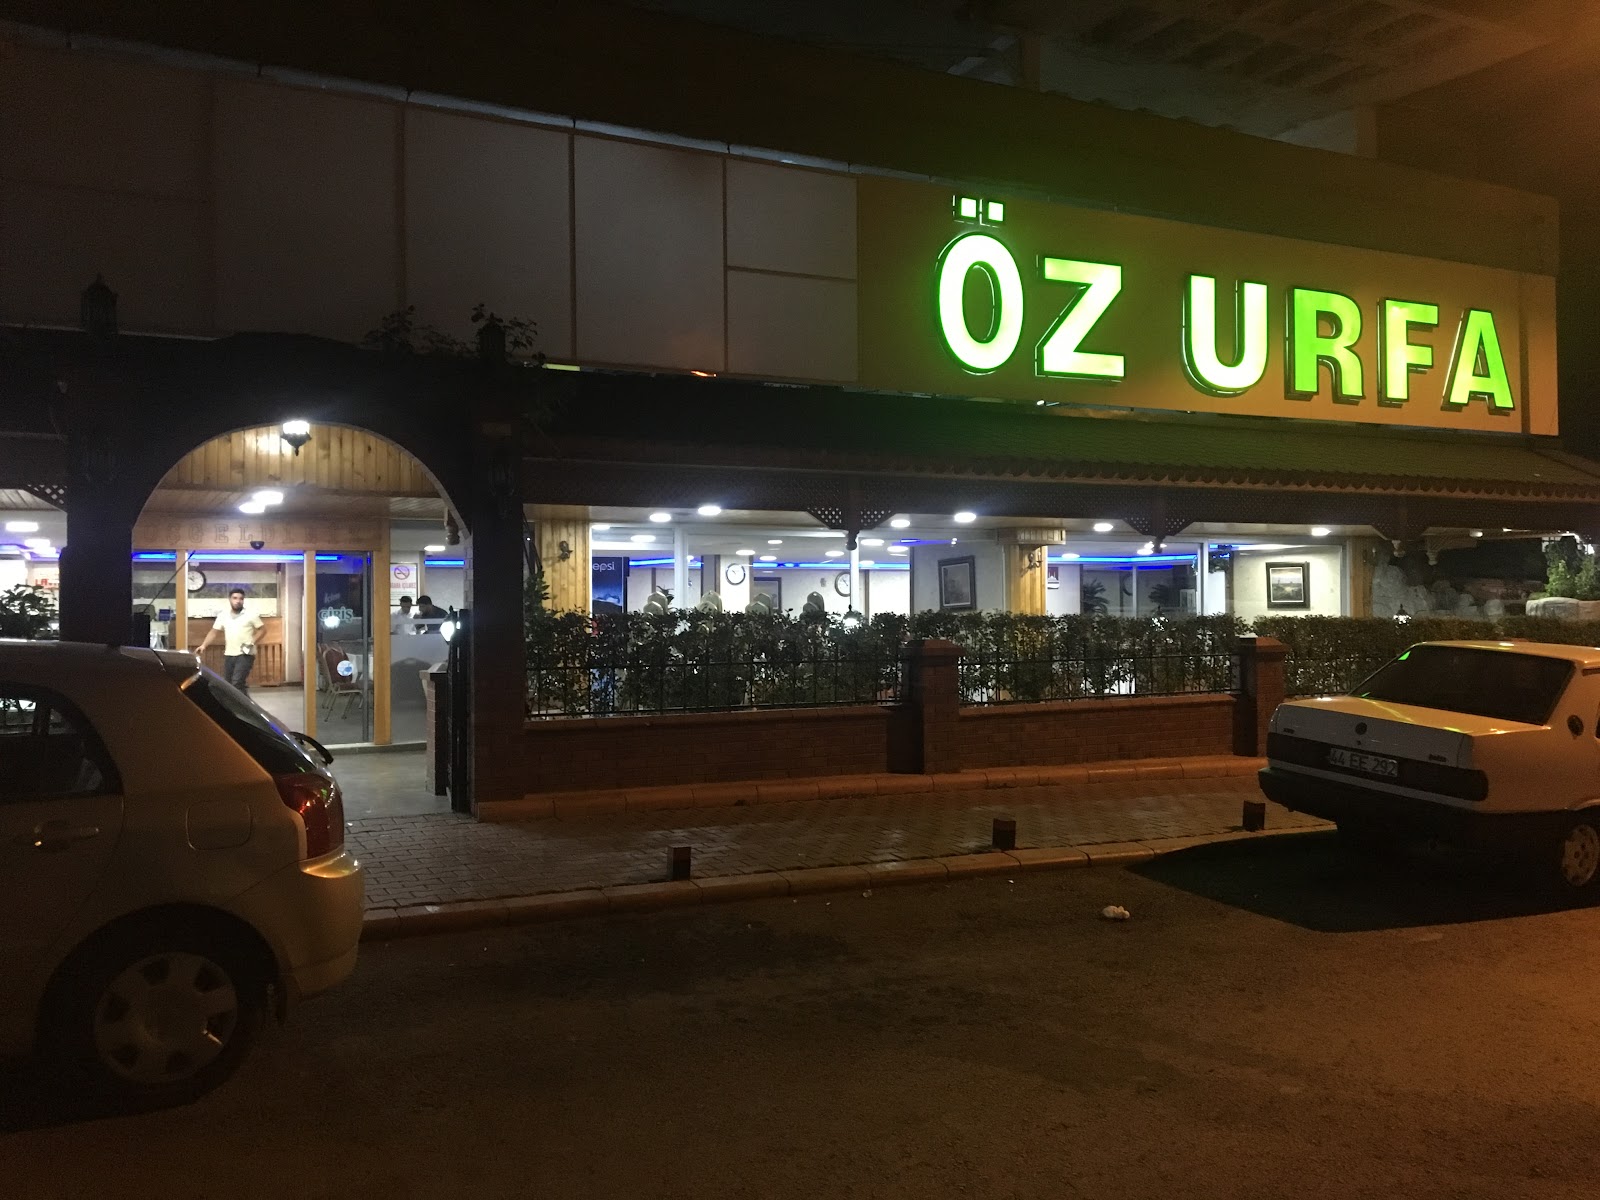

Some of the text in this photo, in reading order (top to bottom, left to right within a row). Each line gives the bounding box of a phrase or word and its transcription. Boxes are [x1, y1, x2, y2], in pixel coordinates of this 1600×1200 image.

[936, 195, 1515, 410] ÖZ URFA
[592, 562, 615, 572] epsi
[1372, 758, 1397, 776] 292
